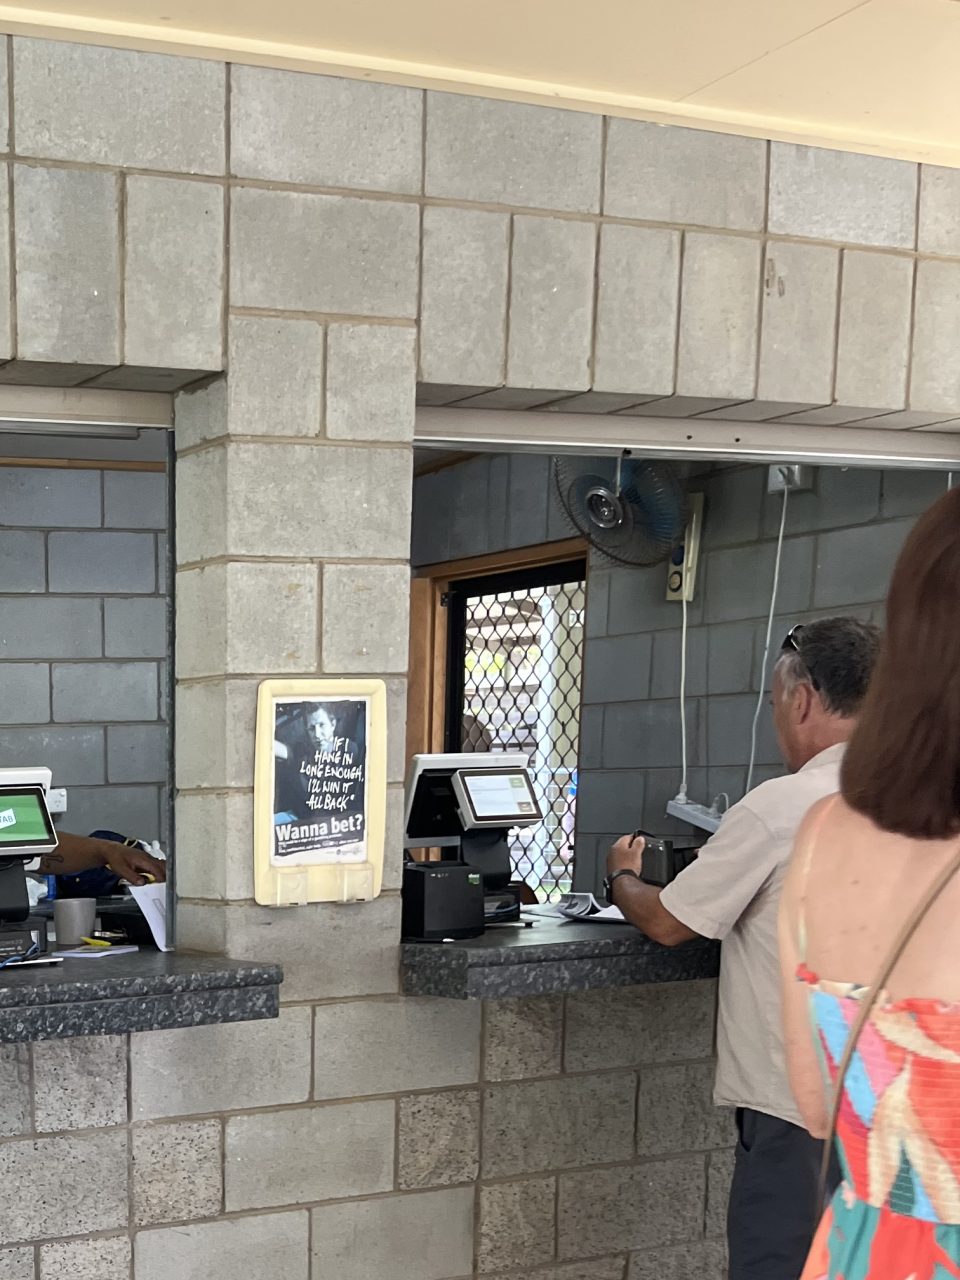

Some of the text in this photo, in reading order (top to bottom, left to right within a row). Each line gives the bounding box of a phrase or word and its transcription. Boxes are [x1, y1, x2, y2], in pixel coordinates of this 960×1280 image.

[314, 750, 354, 766] HANG IN
[300, 761, 323, 777] LONG
[322, 780, 340, 794] WIN
[342, 781, 354, 794] IT
[305, 794, 324, 811] ALL
[275, 822, 329, 842] Wanna
[330, 813, 363, 834] bet?
